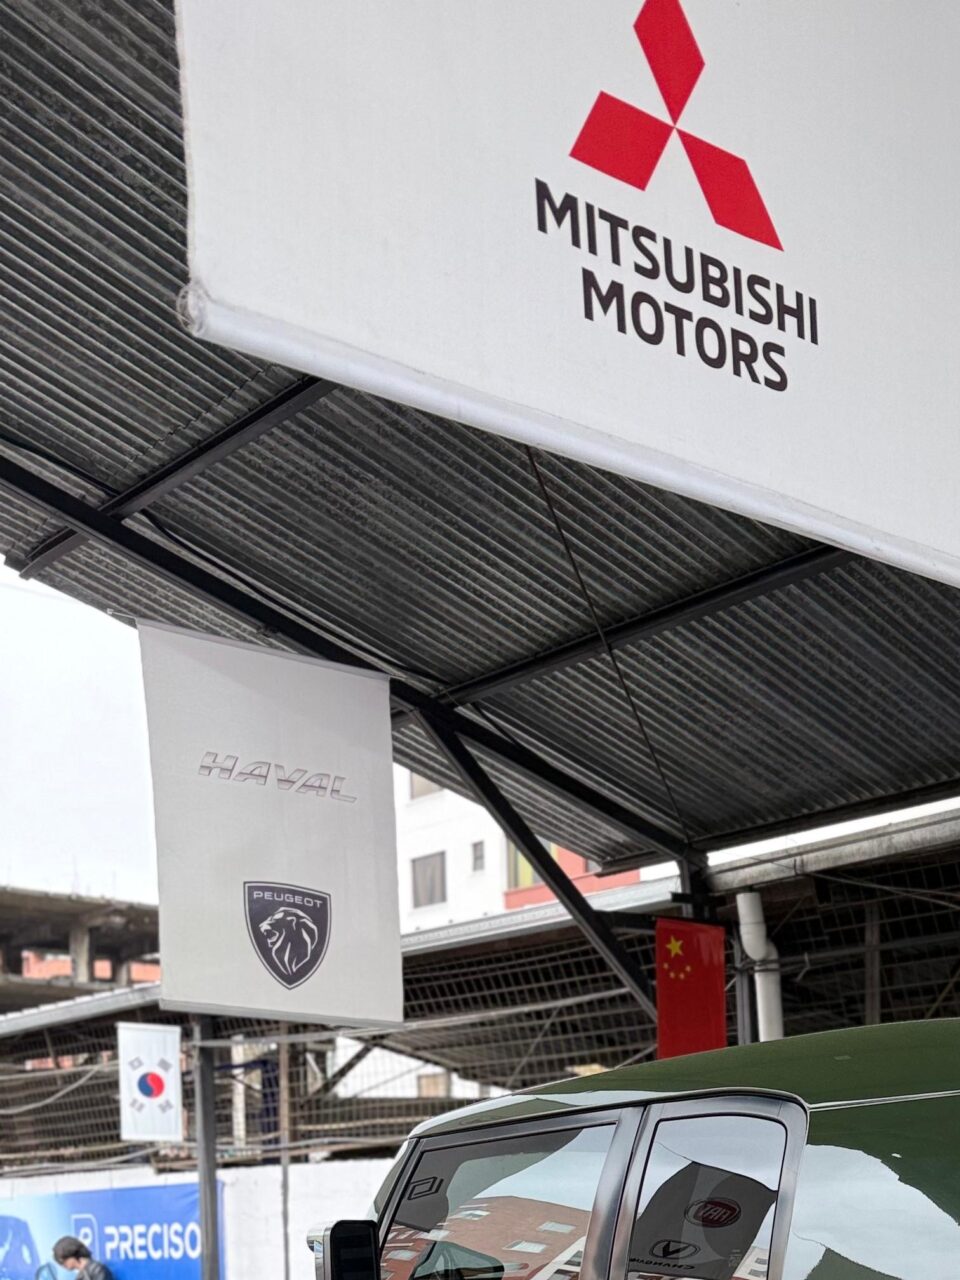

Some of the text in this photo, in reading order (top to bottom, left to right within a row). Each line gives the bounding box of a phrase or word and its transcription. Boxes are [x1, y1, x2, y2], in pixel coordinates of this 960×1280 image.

[535, 177, 818, 346] MITSUBISHI
[582, 267, 788, 392] MOTORS
[198, 751, 357, 804] HAVAL
[253, 890, 324, 909] PEUGEOT
[104, 1222, 201, 1260] PRECISO
